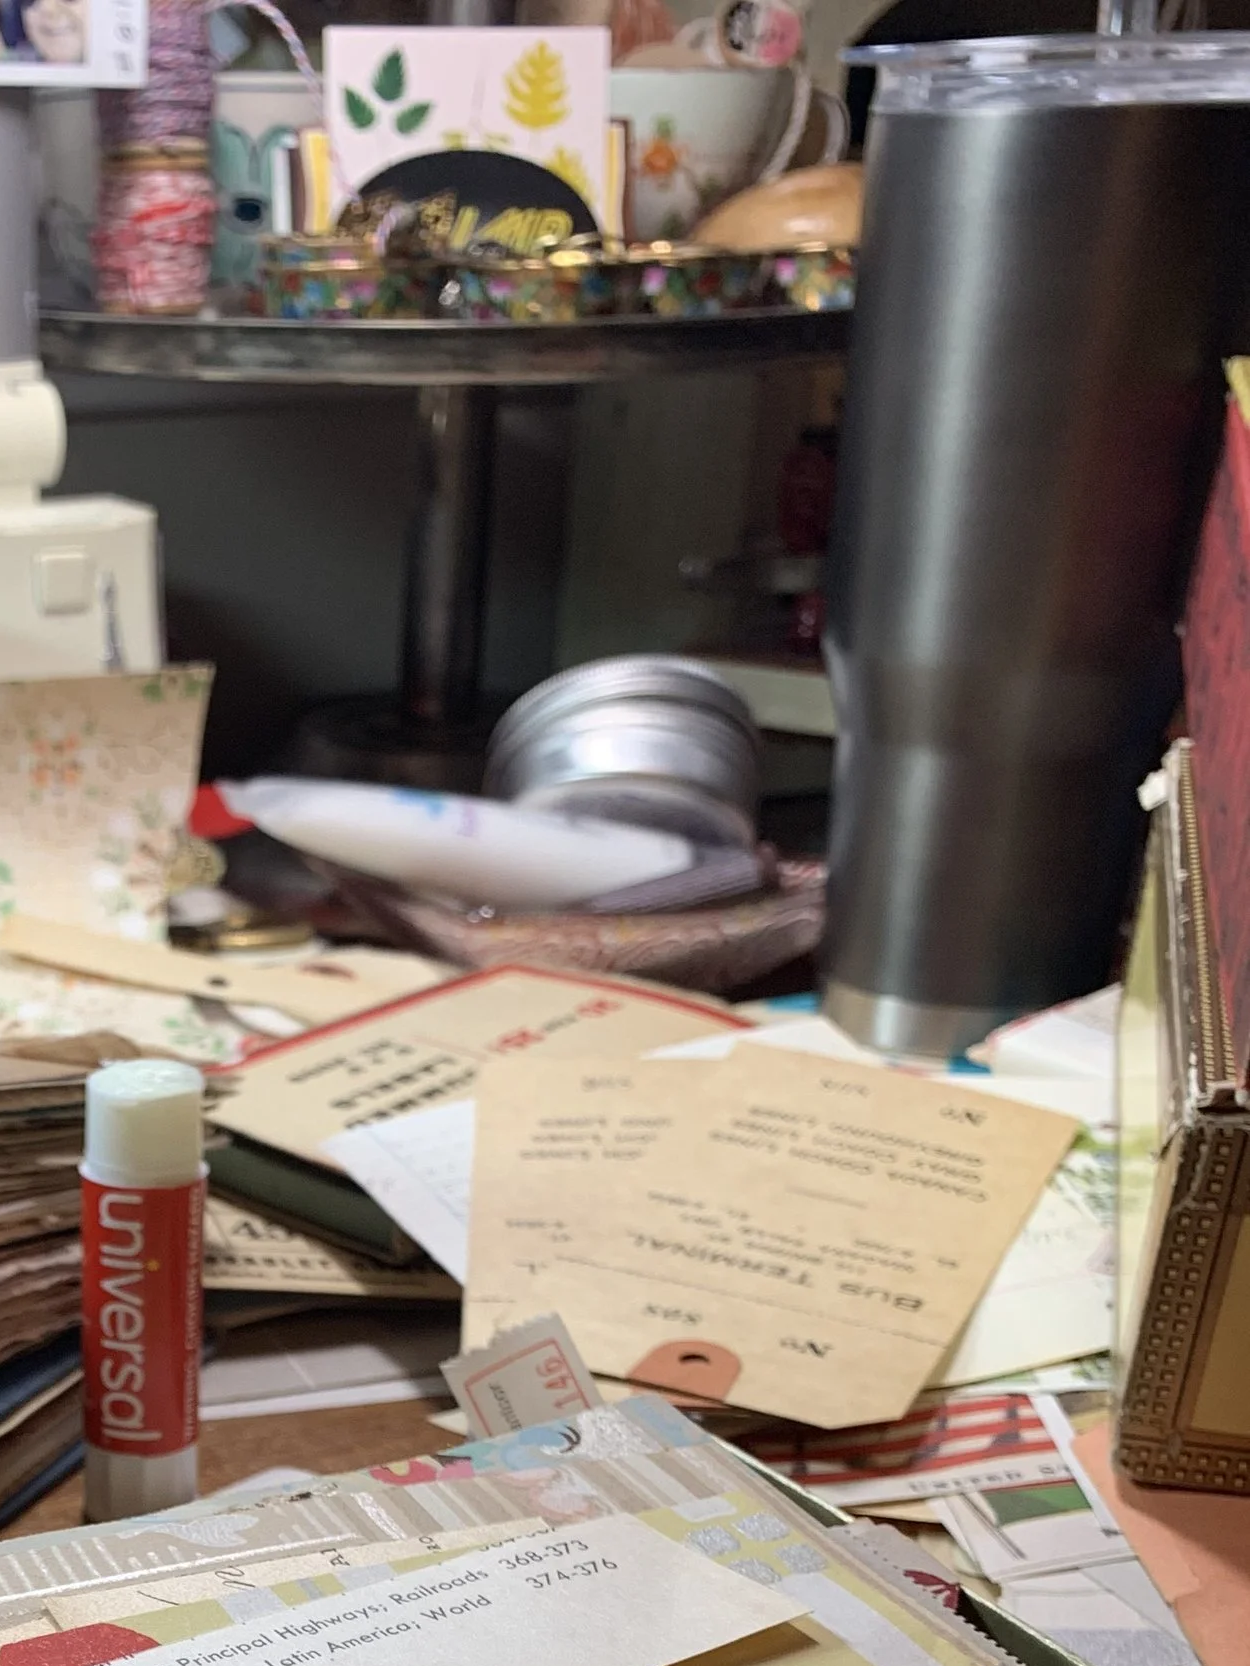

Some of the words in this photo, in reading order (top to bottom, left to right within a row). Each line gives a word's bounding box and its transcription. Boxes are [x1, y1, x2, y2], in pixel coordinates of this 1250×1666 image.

[627, 1226, 816, 1289] TERMINAL
[837, 1279, 925, 1313] BUS
[99, 1193, 162, 1441] universal
[273, 1602, 390, 1642] Highways;
[389, 1567, 491, 1607] Railroads
[497, 1538, 591, 1573] 368-373
[326, 1618, 423, 1656] America;
[420, 1593, 494, 1623] World
[525, 1556, 619, 1591] 374-376
